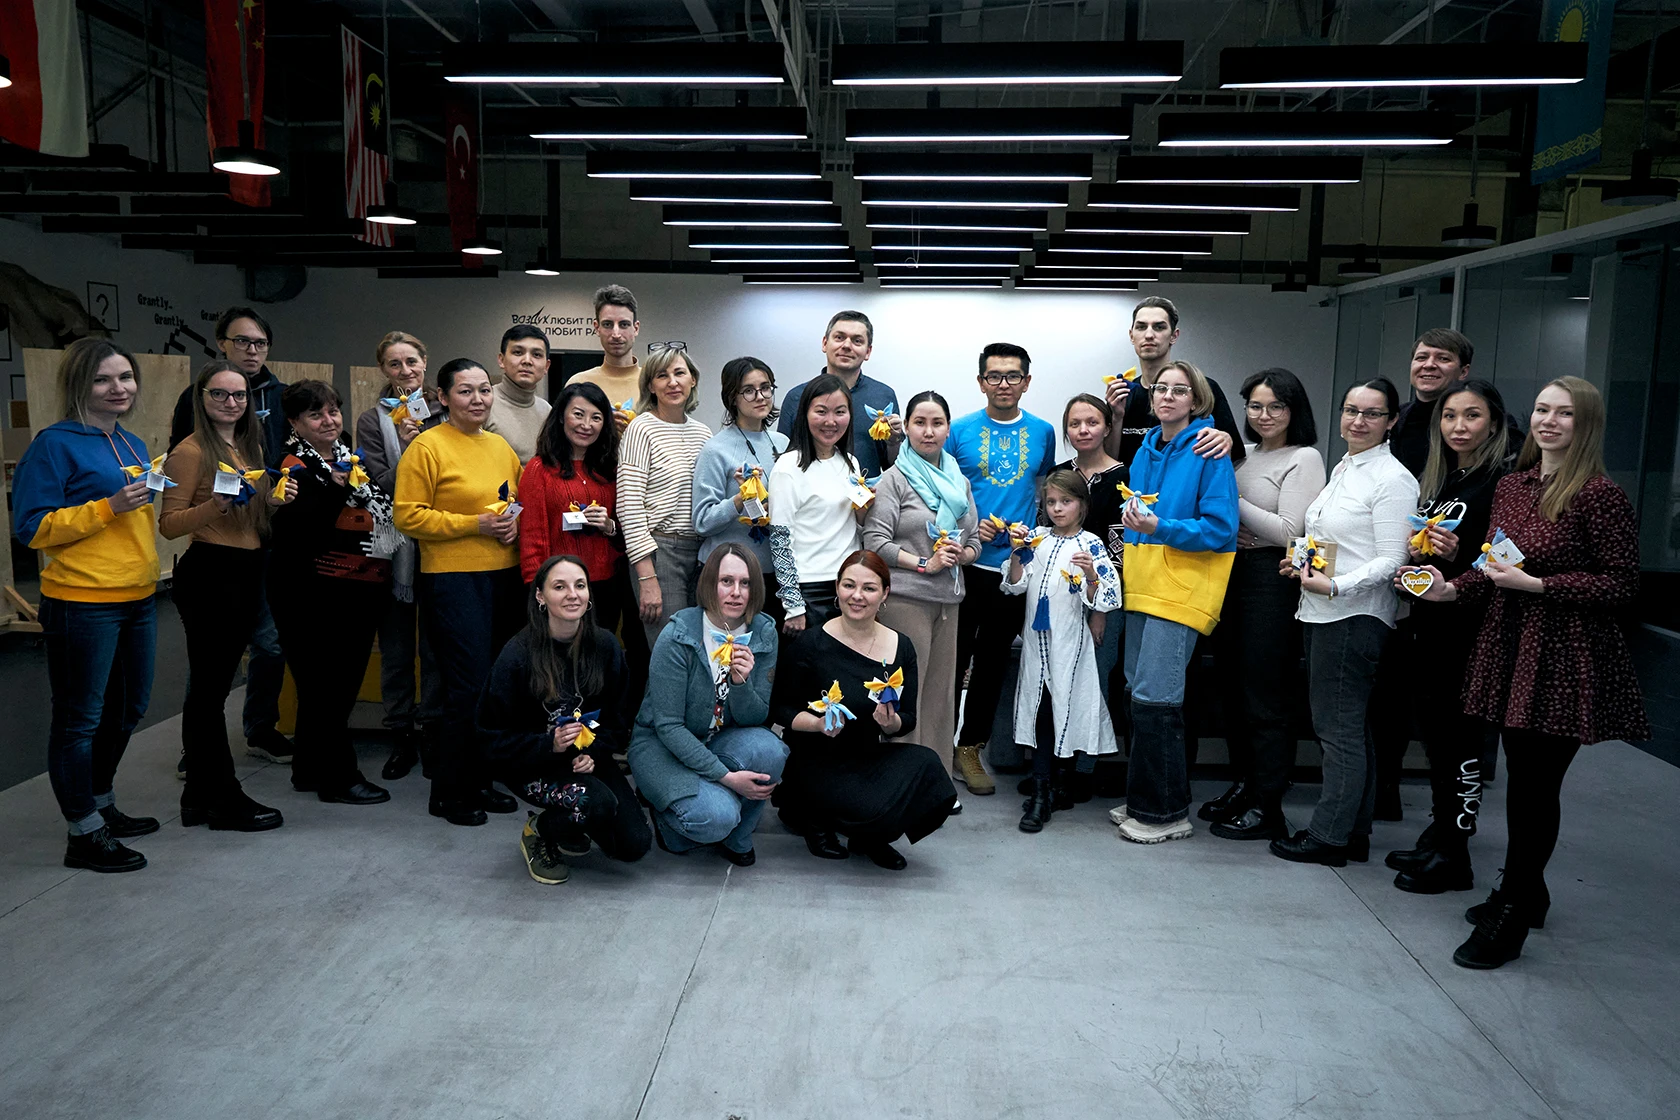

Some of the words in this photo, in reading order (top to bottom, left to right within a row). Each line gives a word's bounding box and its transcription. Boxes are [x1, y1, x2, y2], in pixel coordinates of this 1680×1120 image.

[550, 317, 584, 325] ЛЮБИТ
[545, 327, 583, 336] ЛЮБИТ
[1456, 758, 1482, 830] Calvin
